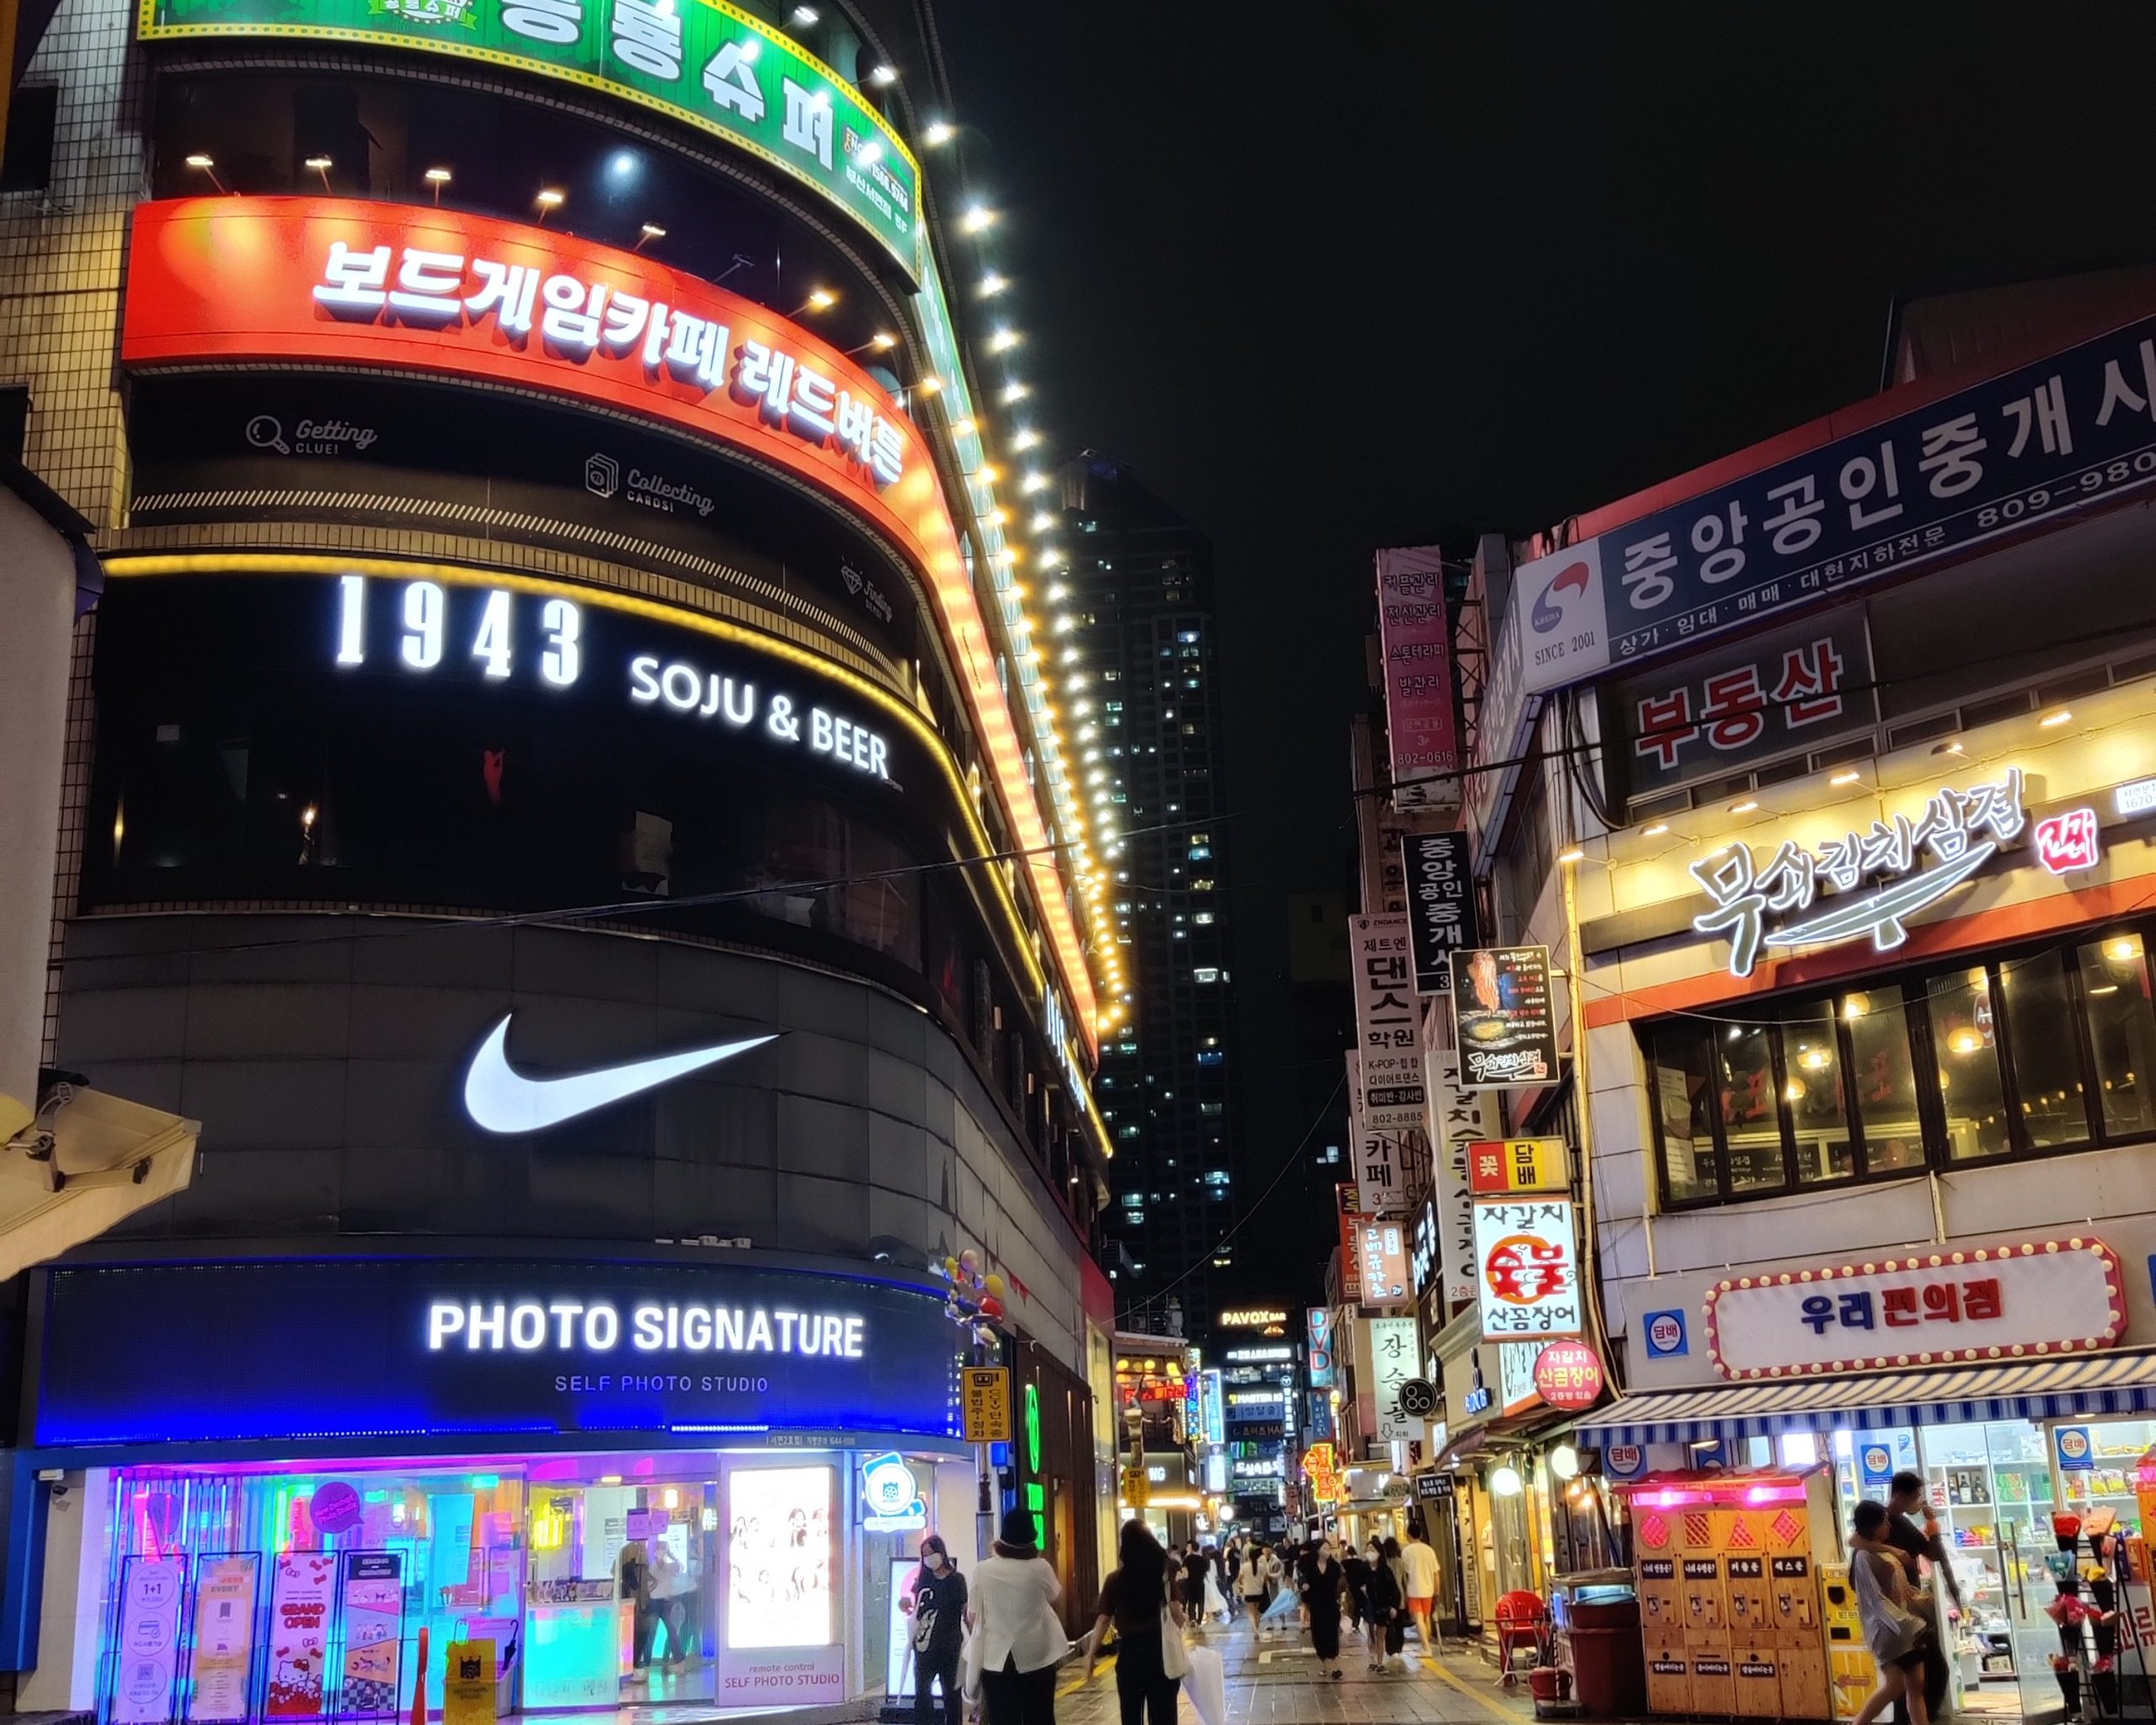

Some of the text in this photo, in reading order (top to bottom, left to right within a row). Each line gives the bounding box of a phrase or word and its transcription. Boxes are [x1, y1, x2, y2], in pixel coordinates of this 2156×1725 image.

[312, 241, 903, 484] 보드게임카페 레드버튼
[296, 419, 377, 450] Getting
[296, 442, 339, 455] CLUE!
[1620, 339, 2156, 610] 중앙공인중개사
[627, 468, 715, 516] Collecting
[627, 491, 675, 513] CARDS!
[1385, 573, 1439, 595] 커플관리
[1619, 627, 1660, 656] 상가
[1677, 606, 1718, 635] 임대
[1738, 584, 1780, 612] 매매
[1800, 526, 1947, 589] 대현지하전문
[1387, 604, 1442, 626] 전신관리
[337, 575, 581, 685] 1943
[1390, 644, 1444, 666] 스톤테라피
[1534, 630, 1596, 665] SINCE 2001
[1398, 675, 1440, 697] 발관리
[1636, 637, 1844, 772] 부동산
[630, 655, 889, 780] SOJU & BEER
[1397, 751, 1453, 765] 802-0616
[1364, 936, 1407, 952] 제트엔
[1366, 956, 1412, 1025] 댄스
[1368, 1029, 1415, 1049] 학원
[1373, 1112, 1423, 1124] 802-8885
[1365, 1140, 1391, 1188] 카페
[1479, 1155, 1499, 1178] 꽃
[1514, 1144, 1536, 1185] 담배
[1482, 1204, 1564, 1230] 자갈치
[1222, 1311, 1268, 1325] PAVOX
[1801, 1279, 2004, 1335] 우리편의점
[430, 1305, 863, 1358] PHOTO SIGNATURE
[1309, 1308, 1330, 1370] DVD
[1654, 1323, 1678, 1339] 담배
[1548, 1350, 1588, 1364] 자갈치
[555, 1375, 768, 1392] SELF PHOTO STUDIO
[1611, 1448, 1637, 1461] 담배
[2063, 1438, 2084, 1450] 담배
[1867, 1455, 1886, 1466] 담배
[144, 1583, 162, 1595] 1+1
[280, 1603, 326, 1616] GRAND
[284, 1616, 320, 1629] OPEN
[749, 1662, 815, 1673] remote control
[724, 1673, 840, 1689] SELF PHOTO STUDIO
